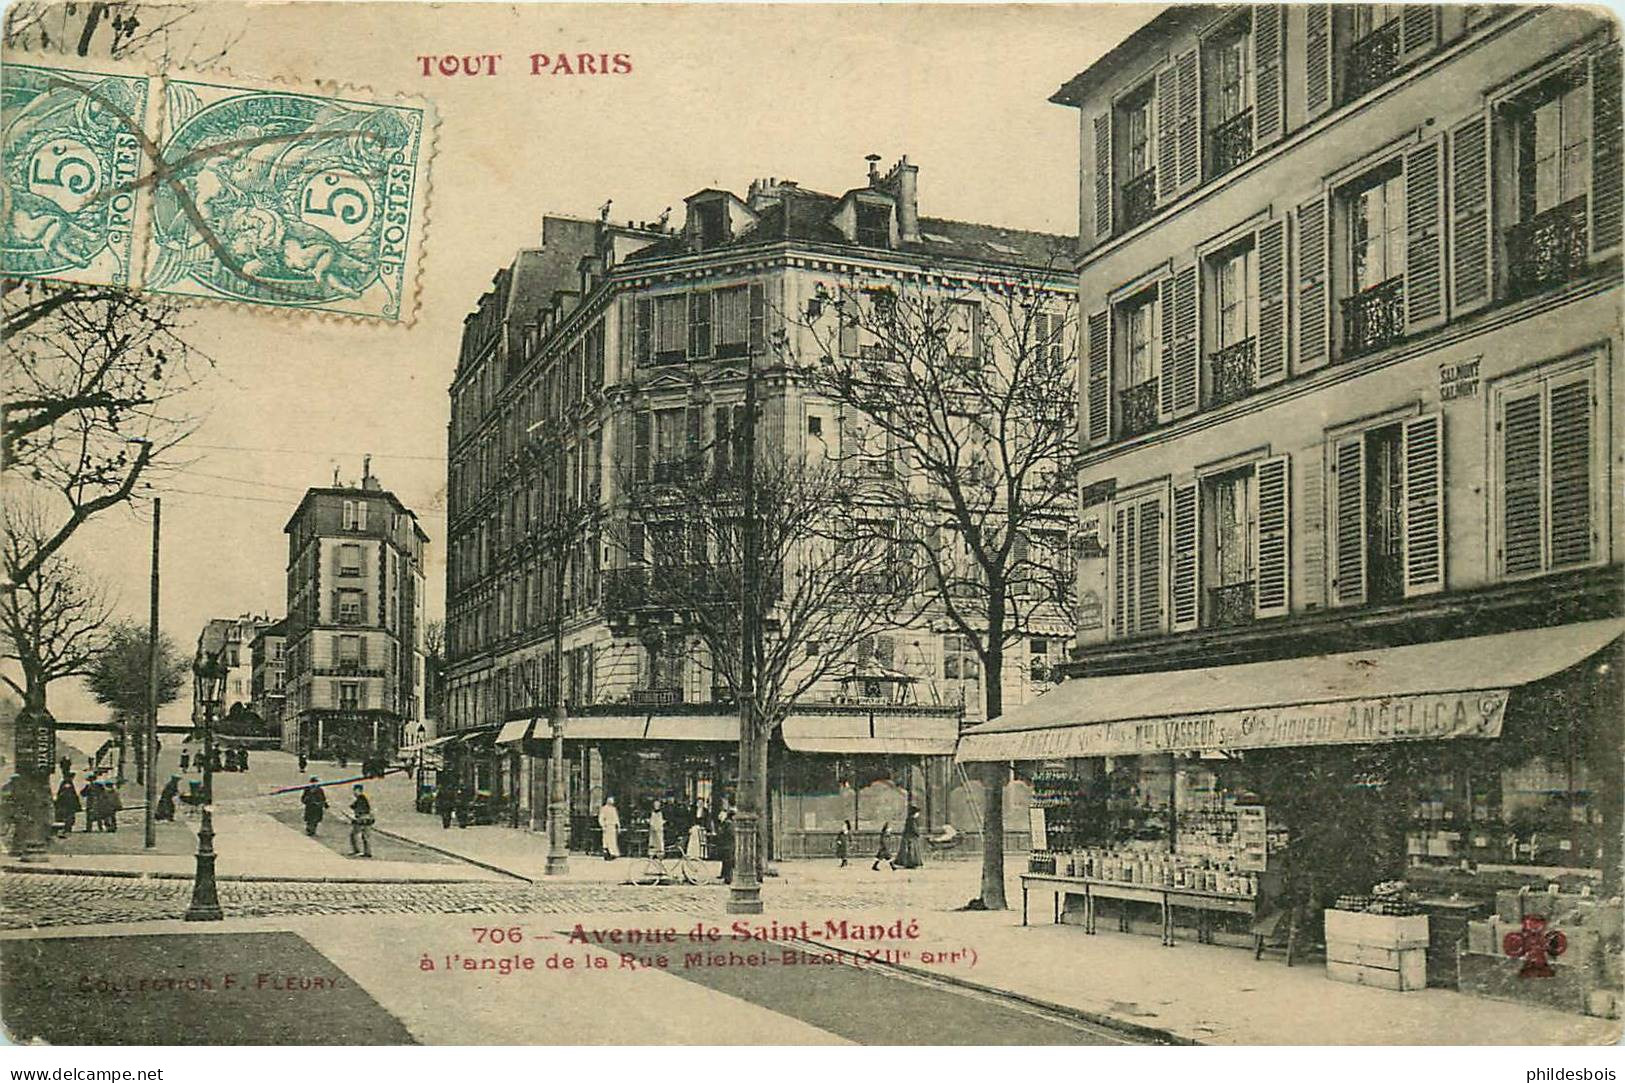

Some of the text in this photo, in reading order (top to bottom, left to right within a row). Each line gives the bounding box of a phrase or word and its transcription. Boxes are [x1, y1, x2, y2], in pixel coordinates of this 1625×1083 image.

[110, 132, 138, 229] POSTES
[382, 164, 412, 262] POSTES
[1344, 700, 1468, 739] ANGELICA
